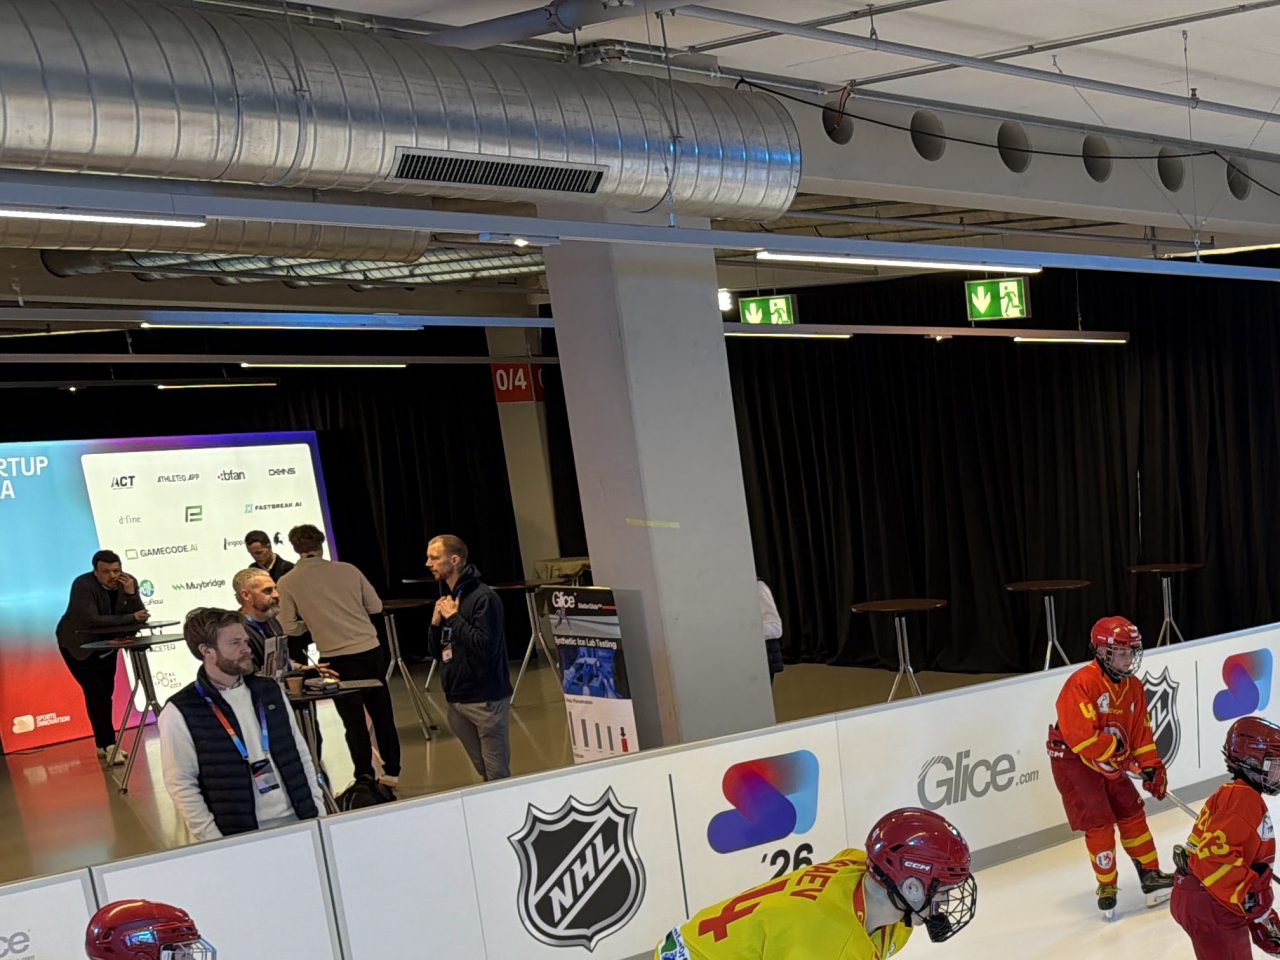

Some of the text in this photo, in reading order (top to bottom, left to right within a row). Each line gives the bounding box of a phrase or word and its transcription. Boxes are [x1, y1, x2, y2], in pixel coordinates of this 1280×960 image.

[496, 368, 527, 390] 0/4
[111, 475, 136, 488] ACT
[185, 580, 226, 590] Muybridge
[552, 591, 576, 609] Glice
[554, 636, 618, 650] Synthetic Ice Lab Testing
[1079, 702, 1096, 720] 4
[917, 749, 1016, 811] Glice
[904, 861, 930, 871] CCM
[549, 832, 616, 924] NHL
